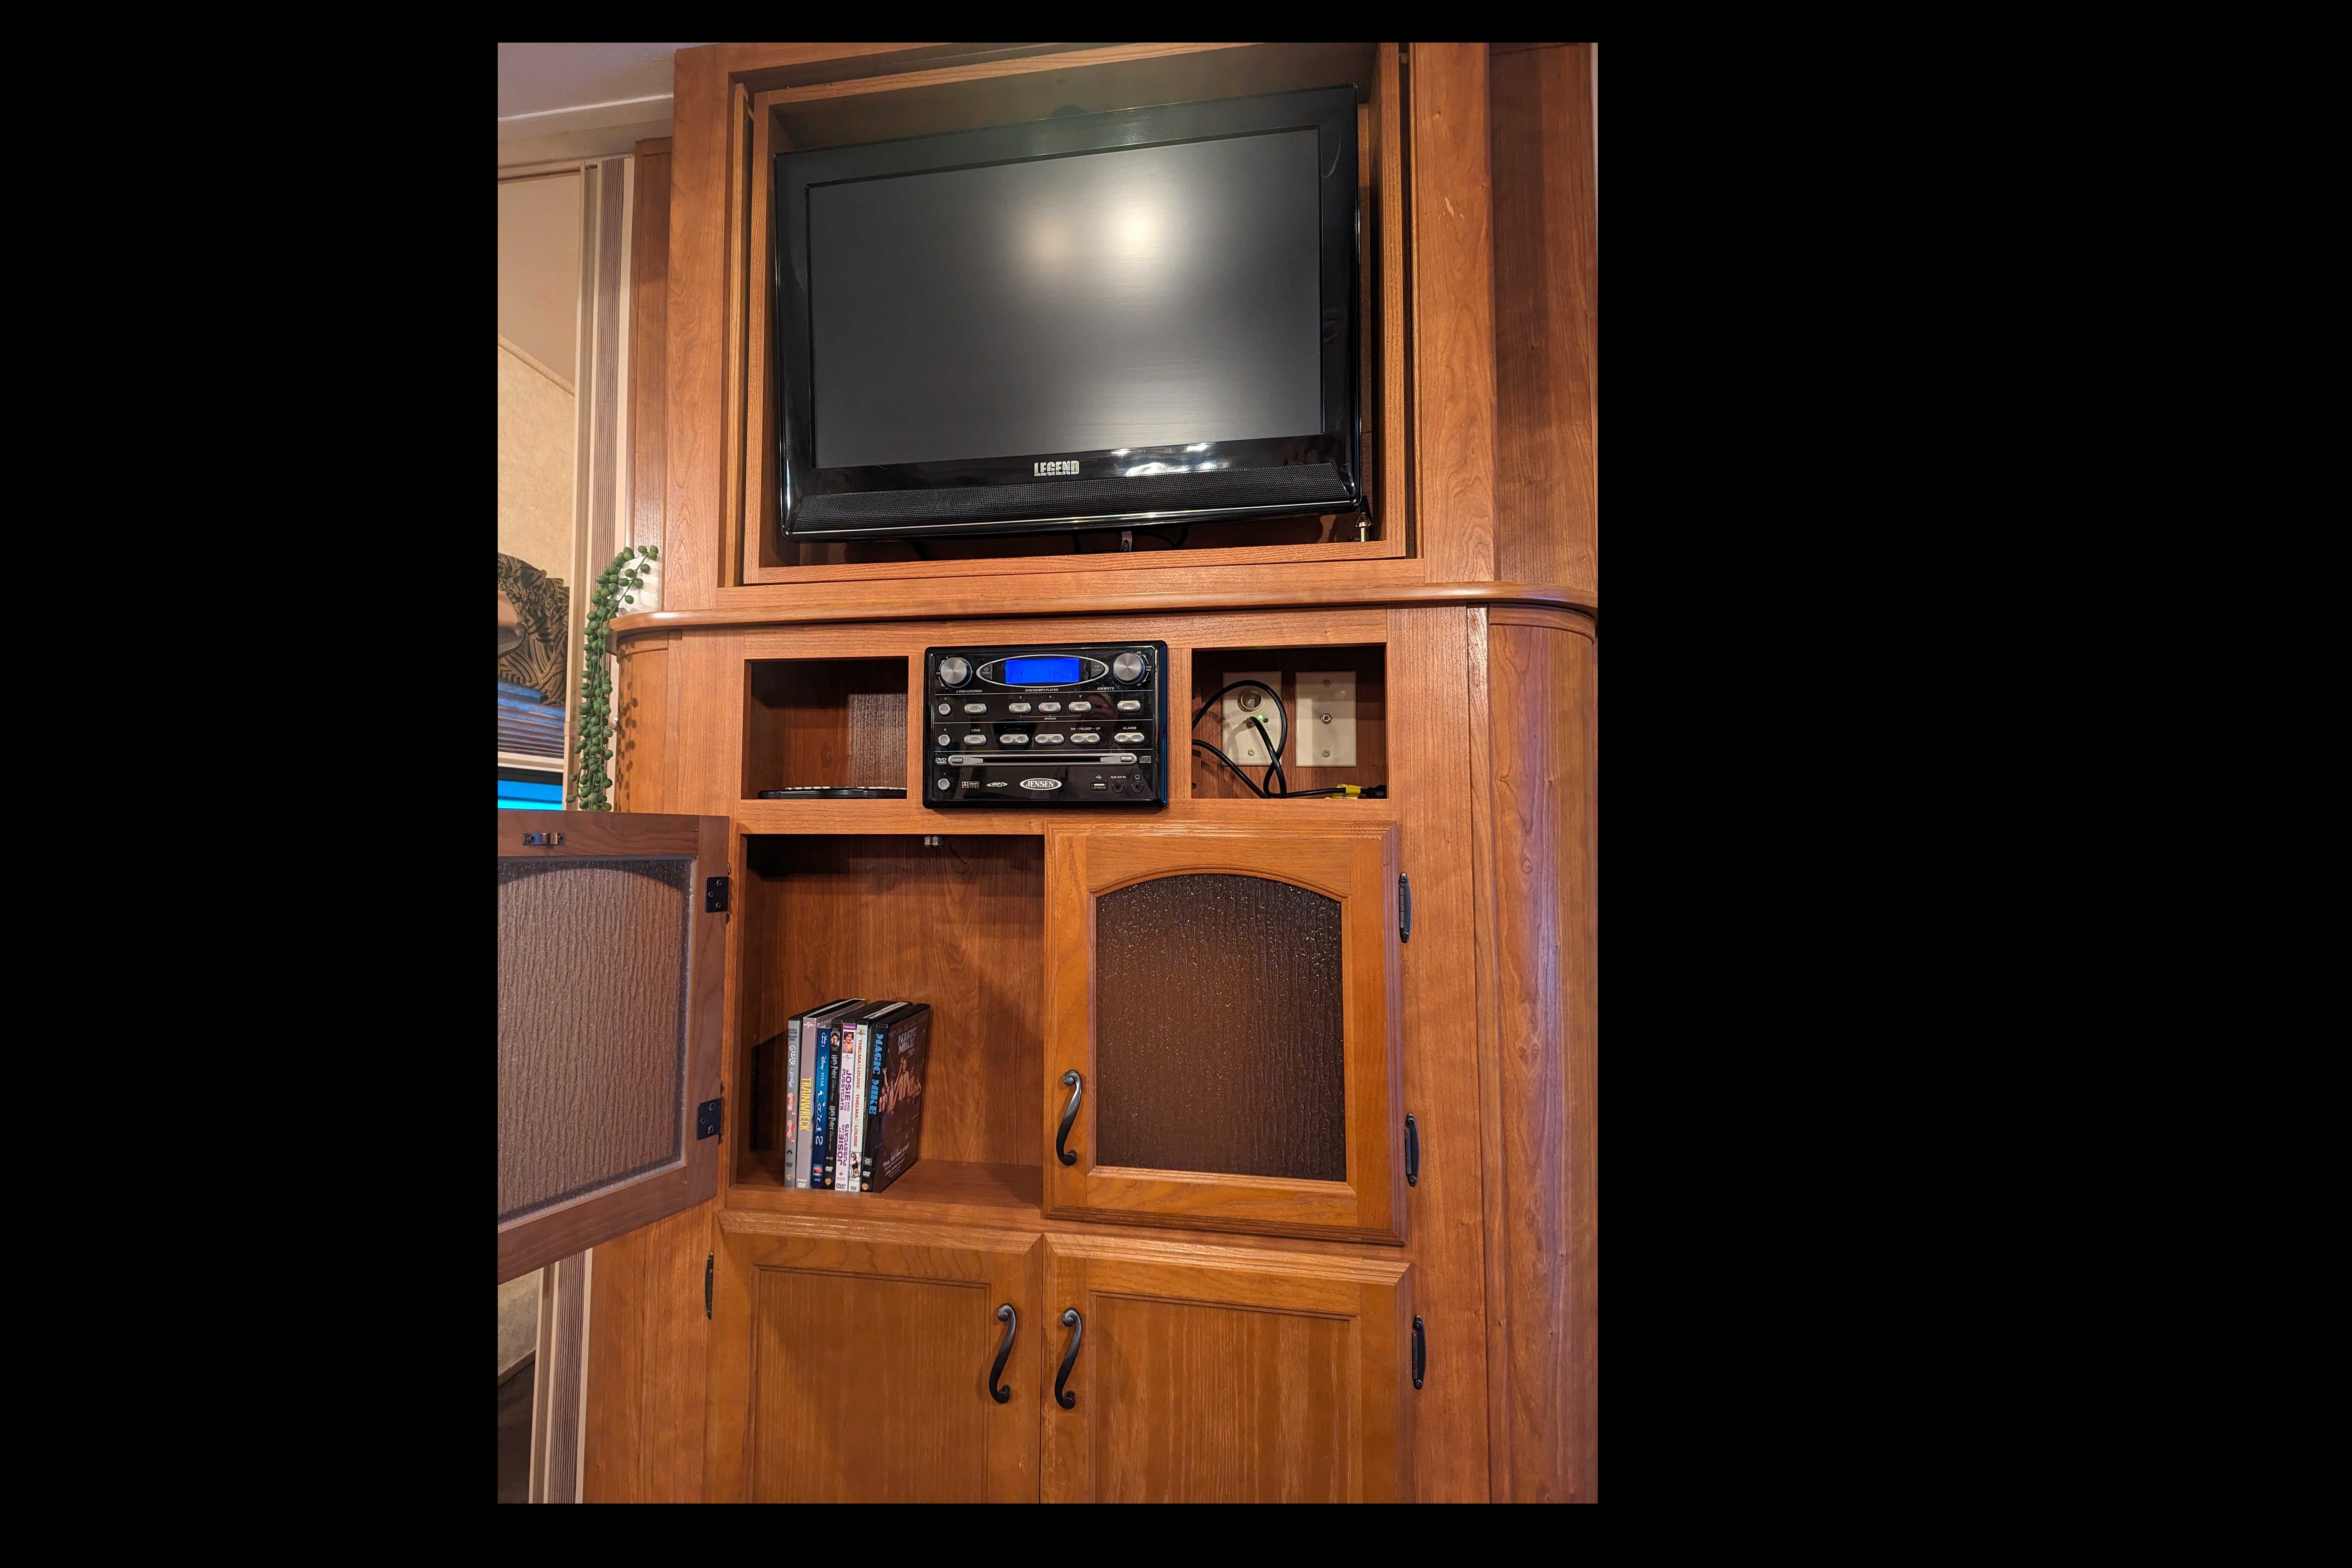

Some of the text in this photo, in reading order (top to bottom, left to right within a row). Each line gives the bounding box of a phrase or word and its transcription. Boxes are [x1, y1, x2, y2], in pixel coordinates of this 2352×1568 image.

[1034, 460, 1079, 476] LEGEND
[898, 1027, 917, 1045] MAGIC
[898, 1037, 915, 1055] MIKE
[869, 1033, 884, 1115] MAGIC MIKE
[799, 1077, 812, 1131] TRAINWRECK
[815, 1090, 825, 1145] Cars 2
